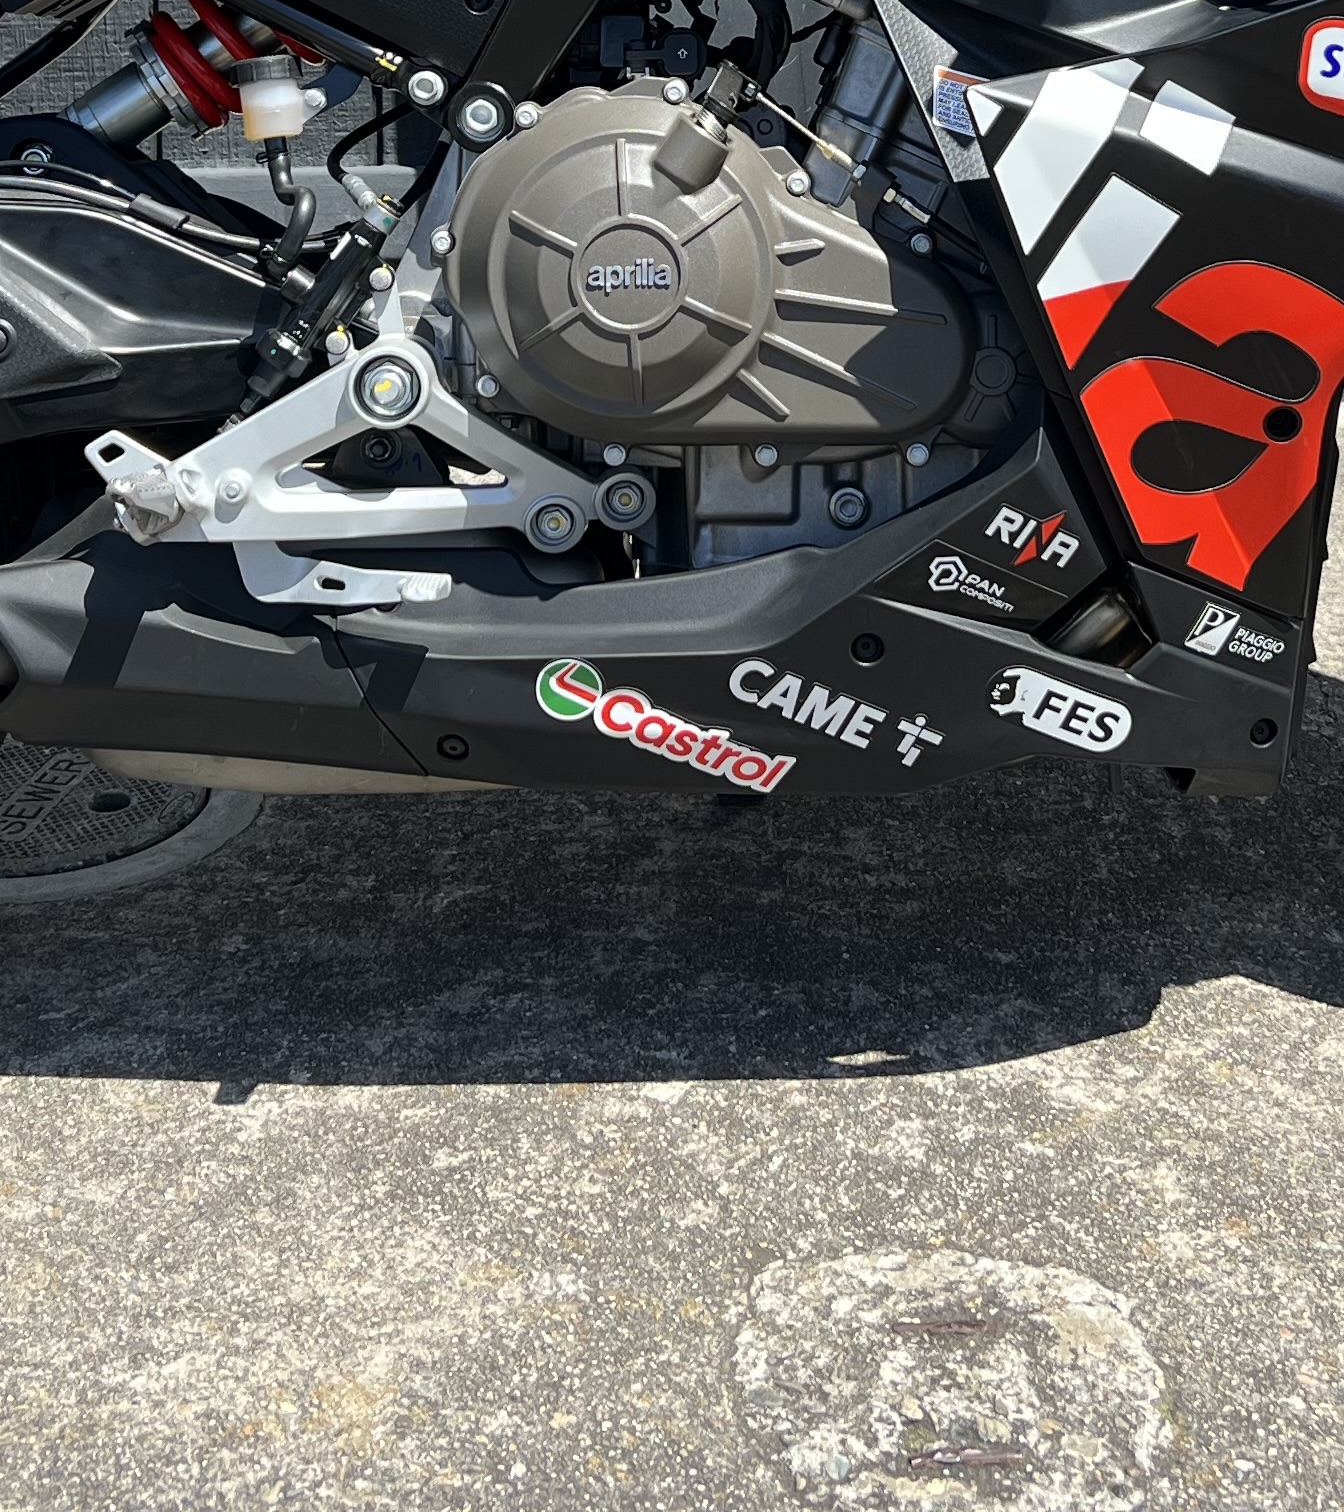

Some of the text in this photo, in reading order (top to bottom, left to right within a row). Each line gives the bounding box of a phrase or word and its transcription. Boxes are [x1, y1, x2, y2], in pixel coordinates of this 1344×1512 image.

[586, 258, 672, 293] aprilia
[985, 502, 1080, 570] RINA
[958, 584, 1015, 613] COMPOSITI
[962, 572, 1006, 597] PAN
[1228, 639, 1275, 663] GROUP
[1234, 626, 1286, 656] PIAGGIO
[728, 660, 887, 749] CAME
[1032, 689, 1121, 744] FES
[600, 693, 787, 789] Castrol
